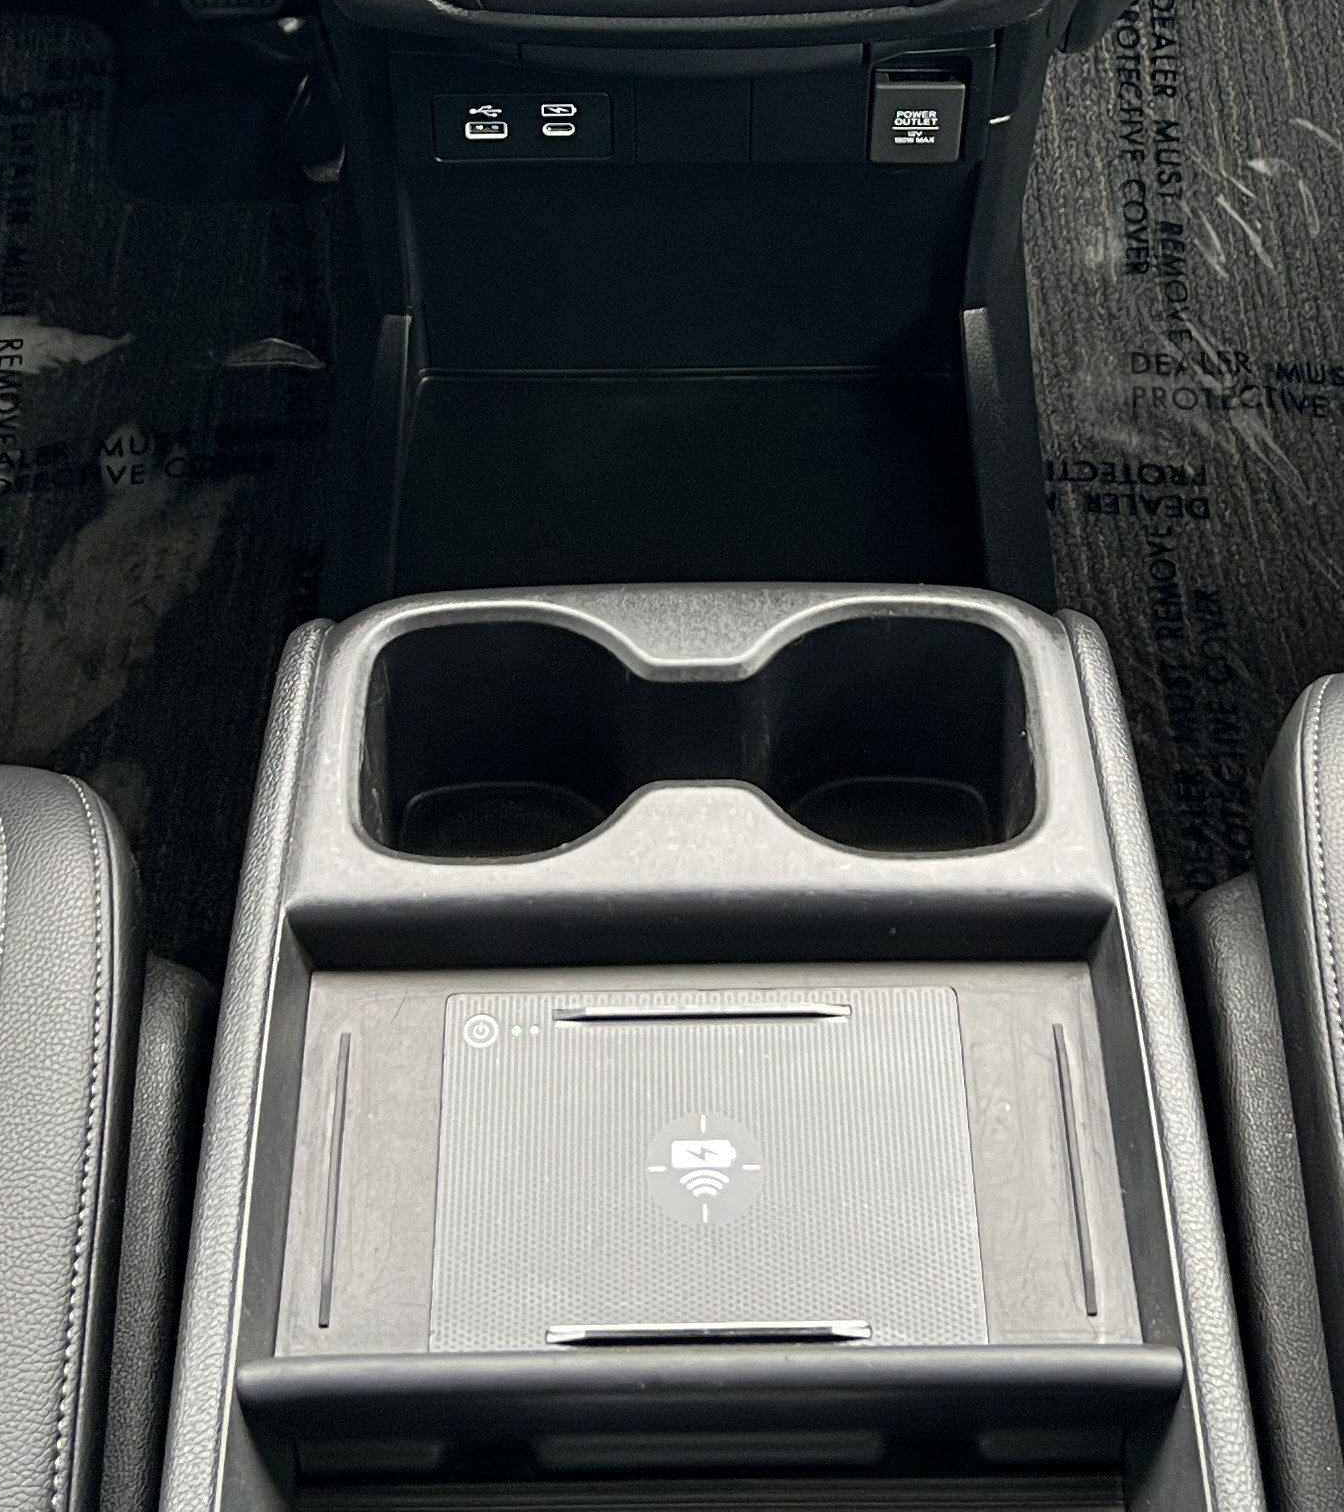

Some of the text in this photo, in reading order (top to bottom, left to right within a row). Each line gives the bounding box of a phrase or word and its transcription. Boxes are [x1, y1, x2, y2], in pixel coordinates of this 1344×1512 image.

[894, 118, 938, 126] OUTLET
[896, 110, 937, 119] POWER
[1155, 120, 1184, 202] MUST
[1121, 179, 1150, 276] COVER
[1158, 220, 1194, 343] REMOVE
[1130, 350, 1253, 378] DEALER
[1133, 386, 1330, 419] PROTECTIVE
[1086, 493, 1210, 521] DEALER
